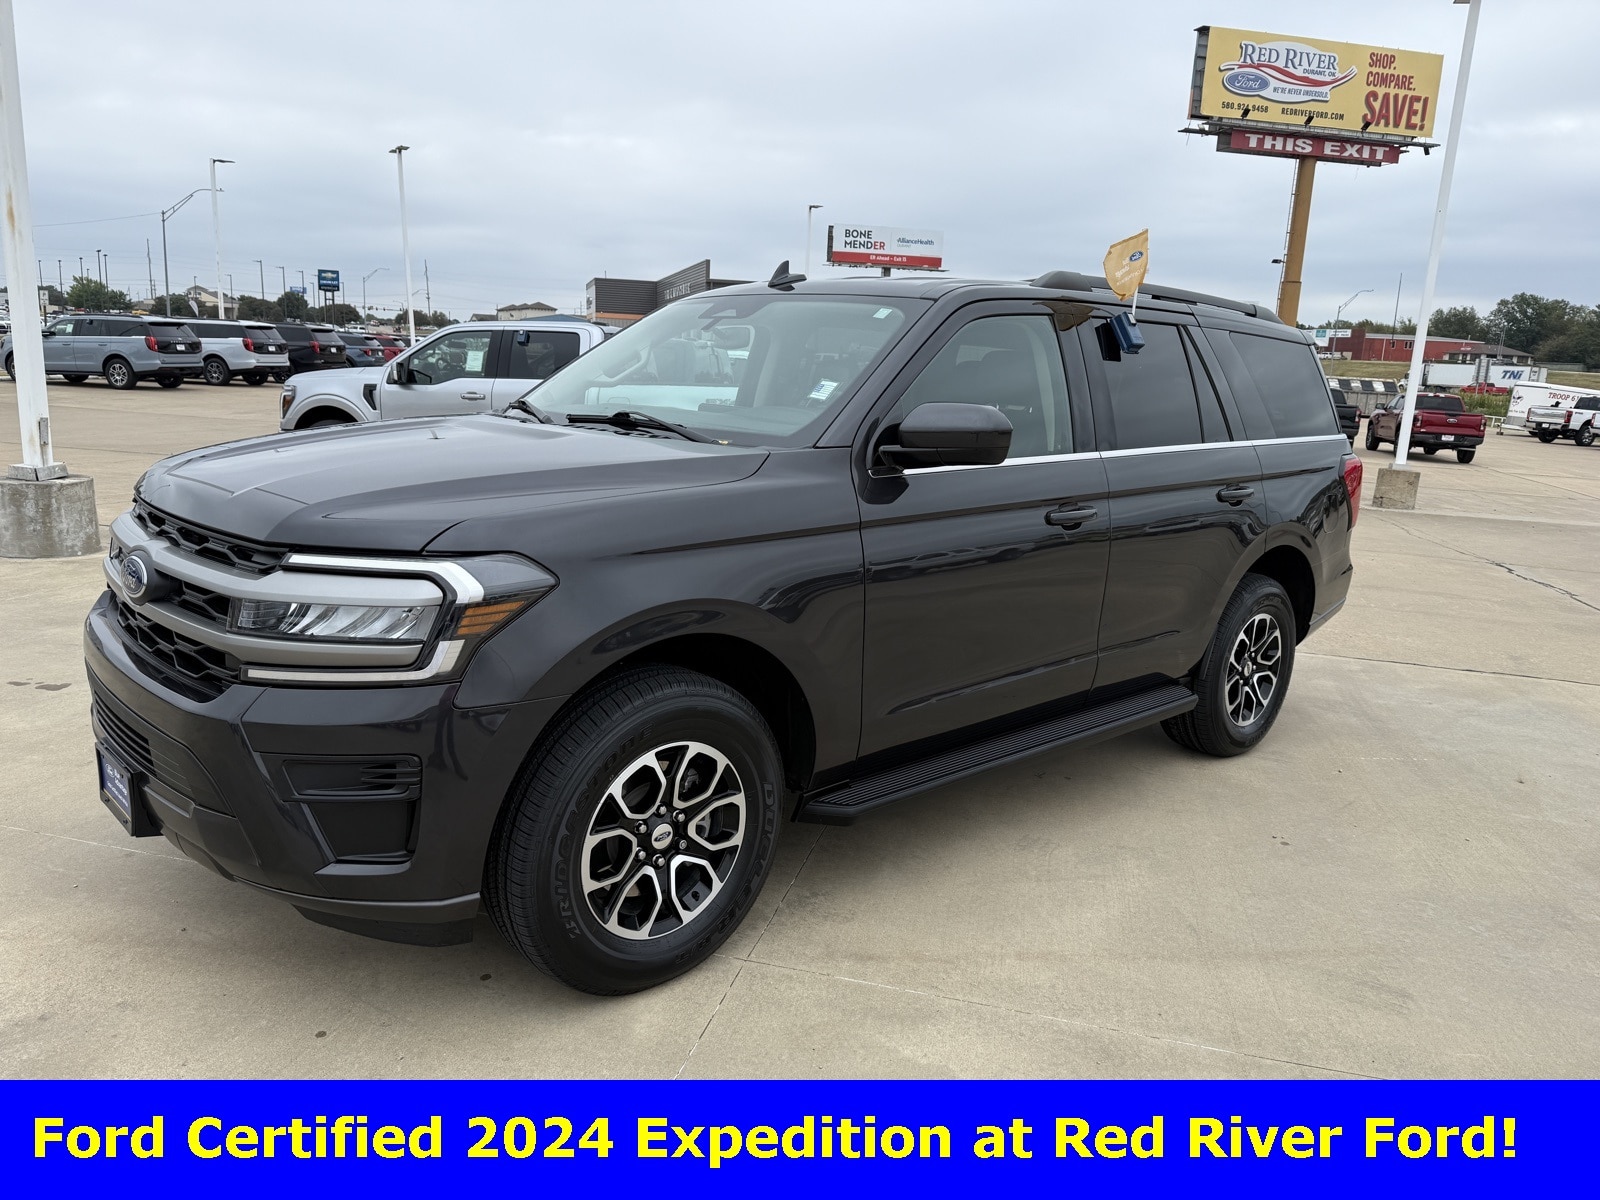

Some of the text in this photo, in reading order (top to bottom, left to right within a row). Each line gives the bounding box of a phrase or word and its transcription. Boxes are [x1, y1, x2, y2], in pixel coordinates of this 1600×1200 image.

[1241, 43, 1337, 70] RED RIVER
[1368, 52, 1397, 70] SHOP.
[1302, 68, 1328, 77] DURANT,
[1234, 73, 1261, 89] Ford
[1365, 71, 1416, 91] COMPARE.
[1272, 86, 1329, 99] WE'RE NEVER UNDERSOLD.
[1280, 107, 1345, 121] REDRIVERFORD.COM
[1361, 90, 1430, 131] SAVE!
[1244, 133, 1389, 160] THIS EXIT
[844, 229, 873, 240] BONE
[897, 237, 935, 246] AllianceHealth
[844, 239, 886, 251] MENDER
[1548, 391, 1571, 401] TROOP
